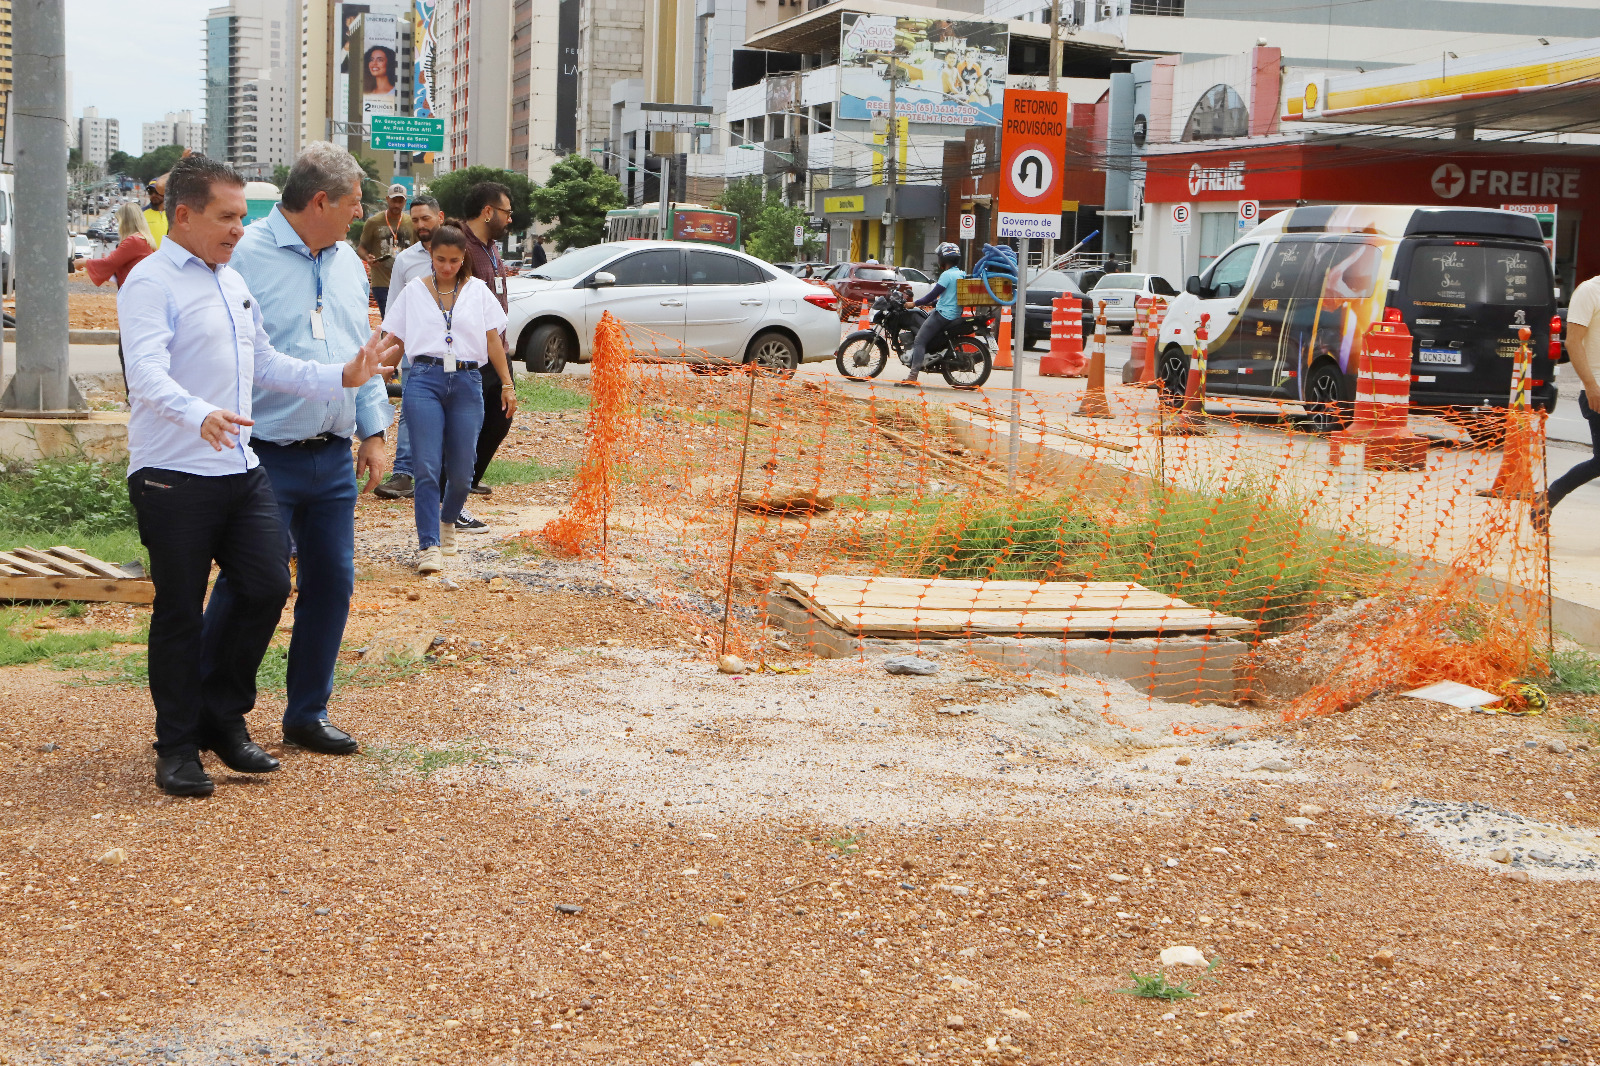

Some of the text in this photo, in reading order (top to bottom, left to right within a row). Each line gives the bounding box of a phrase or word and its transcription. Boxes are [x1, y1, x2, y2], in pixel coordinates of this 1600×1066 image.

[846, 33, 893, 50] QUENTES
[364, 102, 371, 112] 2
[866, 102, 978, 115] RESEVAS: (65) 3614-7500
[1014, 99, 1058, 115] RETORNO
[1007, 118, 1062, 136] PROVISÓRIO
[1202, 168, 1245, 190] FREIRE
[1469, 169, 1580, 198] FREIRE
[1178, 209, 1184, 219] E
[1245, 205, 1252, 215] E
[1509, 205, 1536, 213] POSTO
[965, 218, 970, 226] E
[1002, 216, 1051, 227] Governo de
[1002, 228, 1056, 238] Mato Grosso
[1423, 353, 1456, 362] QCN3J64
